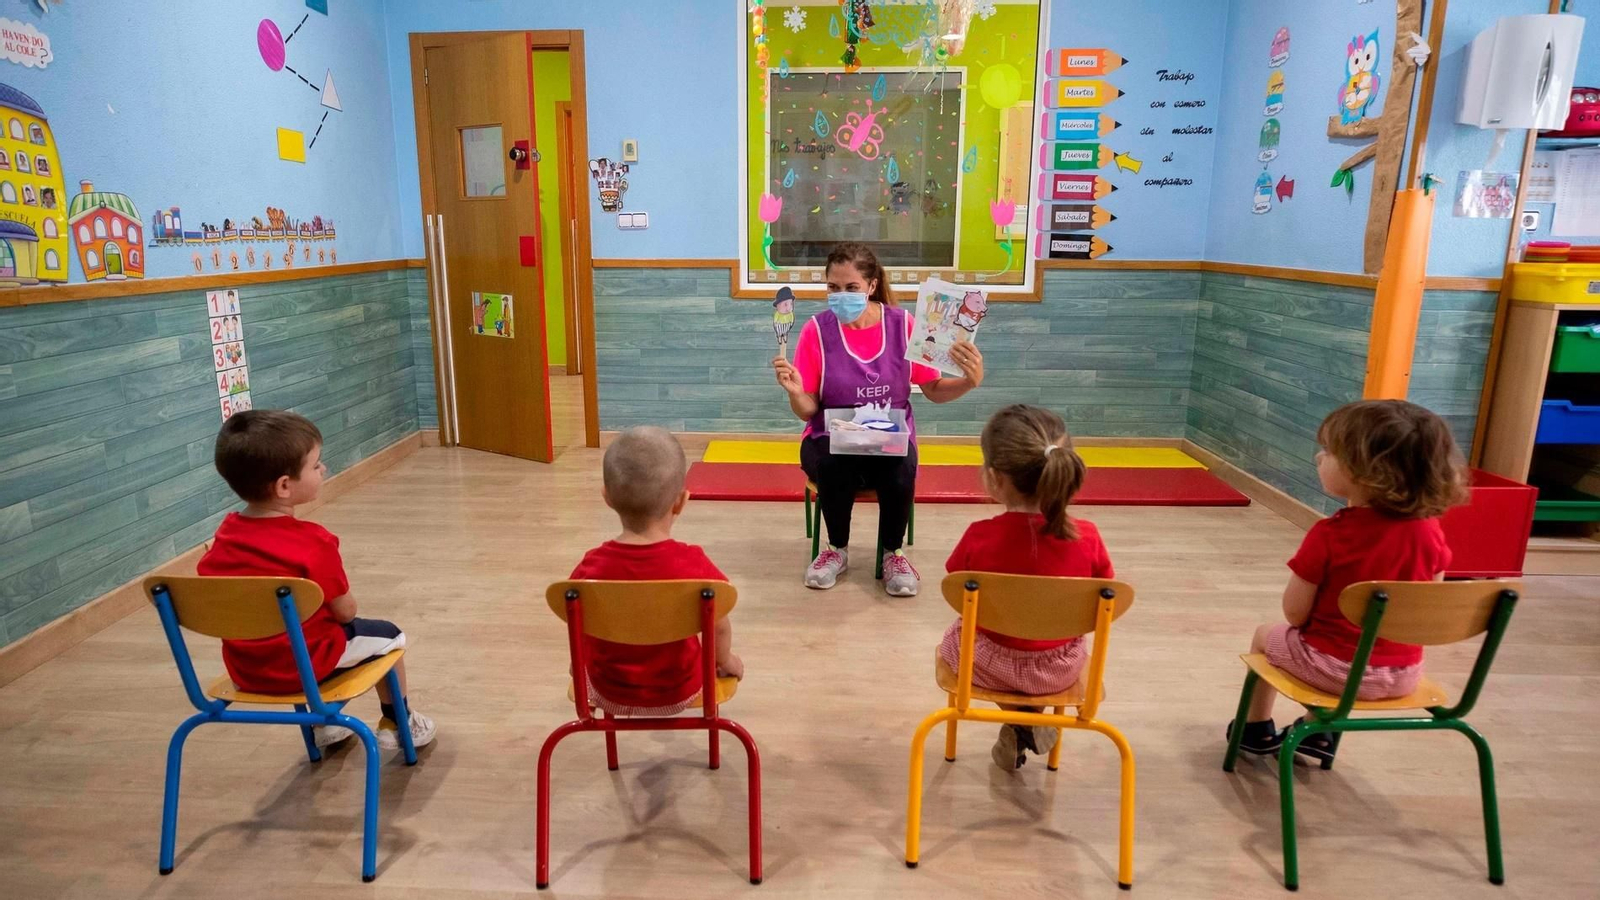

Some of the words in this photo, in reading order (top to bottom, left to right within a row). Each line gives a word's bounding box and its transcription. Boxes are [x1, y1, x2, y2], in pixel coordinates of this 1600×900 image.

[5, 42, 15, 52] AL
[16, 45, 37, 57] COLE
[1069, 58, 1094, 66] Lunes
[1156, 70, 1194, 85] Trabajo
[1066, 88, 1094, 96] Martes
[1173, 100, 1206, 108] esmero
[1061, 121, 1093, 129] Miércoles
[1140, 127, 1154, 135] sin
[1172, 125, 1213, 134] molestar
[794, 137, 836, 160] trabajos
[1063, 151, 1090, 159] Jueves
[1162, 152, 1174, 162] al
[1059, 182, 1090, 190] Viernes
[1144, 177, 1193, 188] compañero
[1053, 241, 1088, 251] Domingo
[232, 256, 239, 269] 2
[211, 294, 219, 312] 1
[213, 321, 222, 340] 2
[215, 349, 224, 367] 3
[220, 374, 229, 392] 4
[857, 385, 890, 398] KEEP
[223, 401, 232, 419] 5
